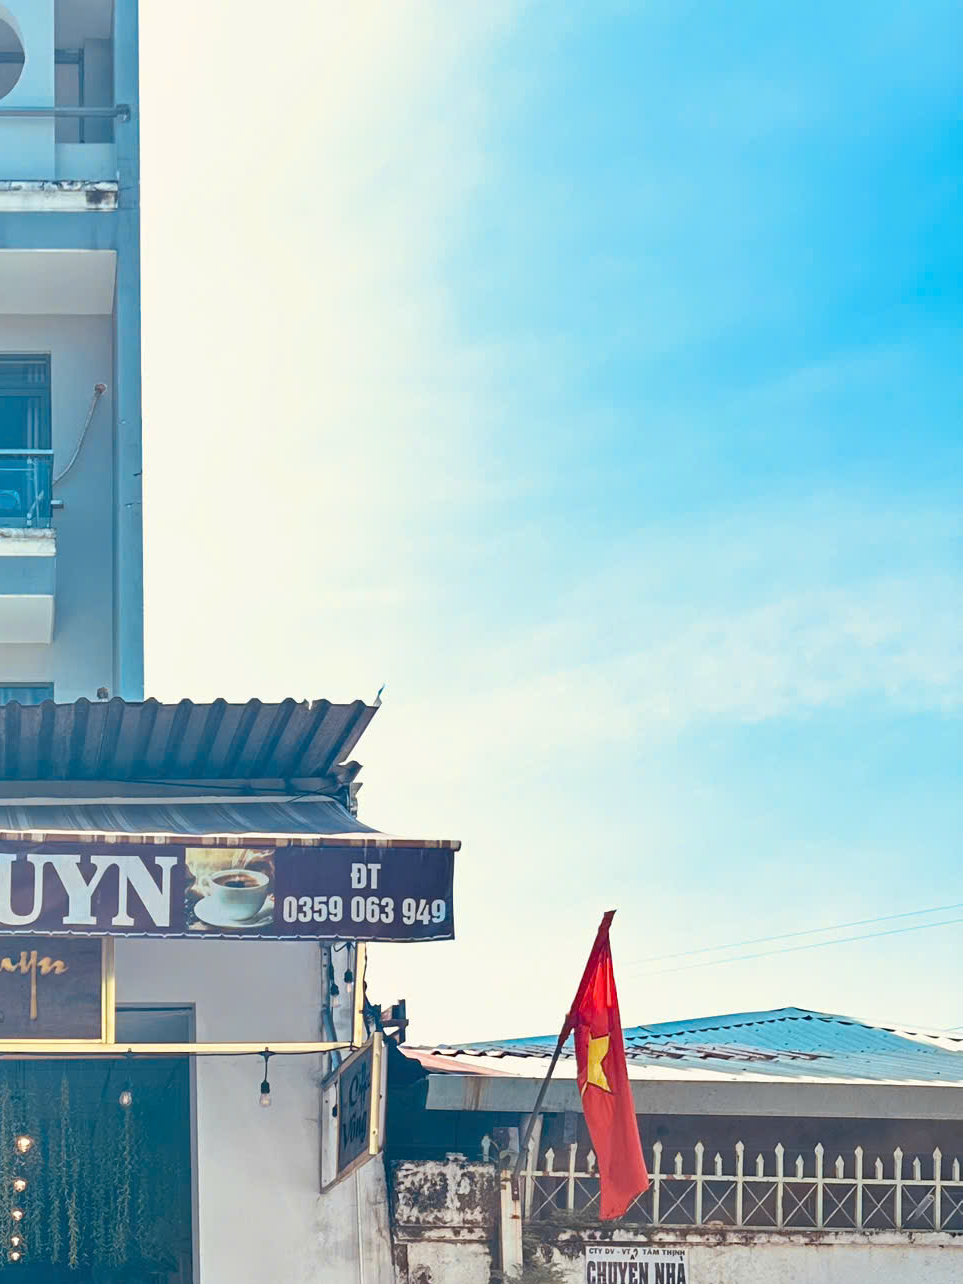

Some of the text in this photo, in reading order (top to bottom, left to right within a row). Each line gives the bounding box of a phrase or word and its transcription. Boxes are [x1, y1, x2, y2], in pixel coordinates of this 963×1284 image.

[350, 863, 382, 890] ĐT
[283, 896, 446, 925] 0359 063 949
